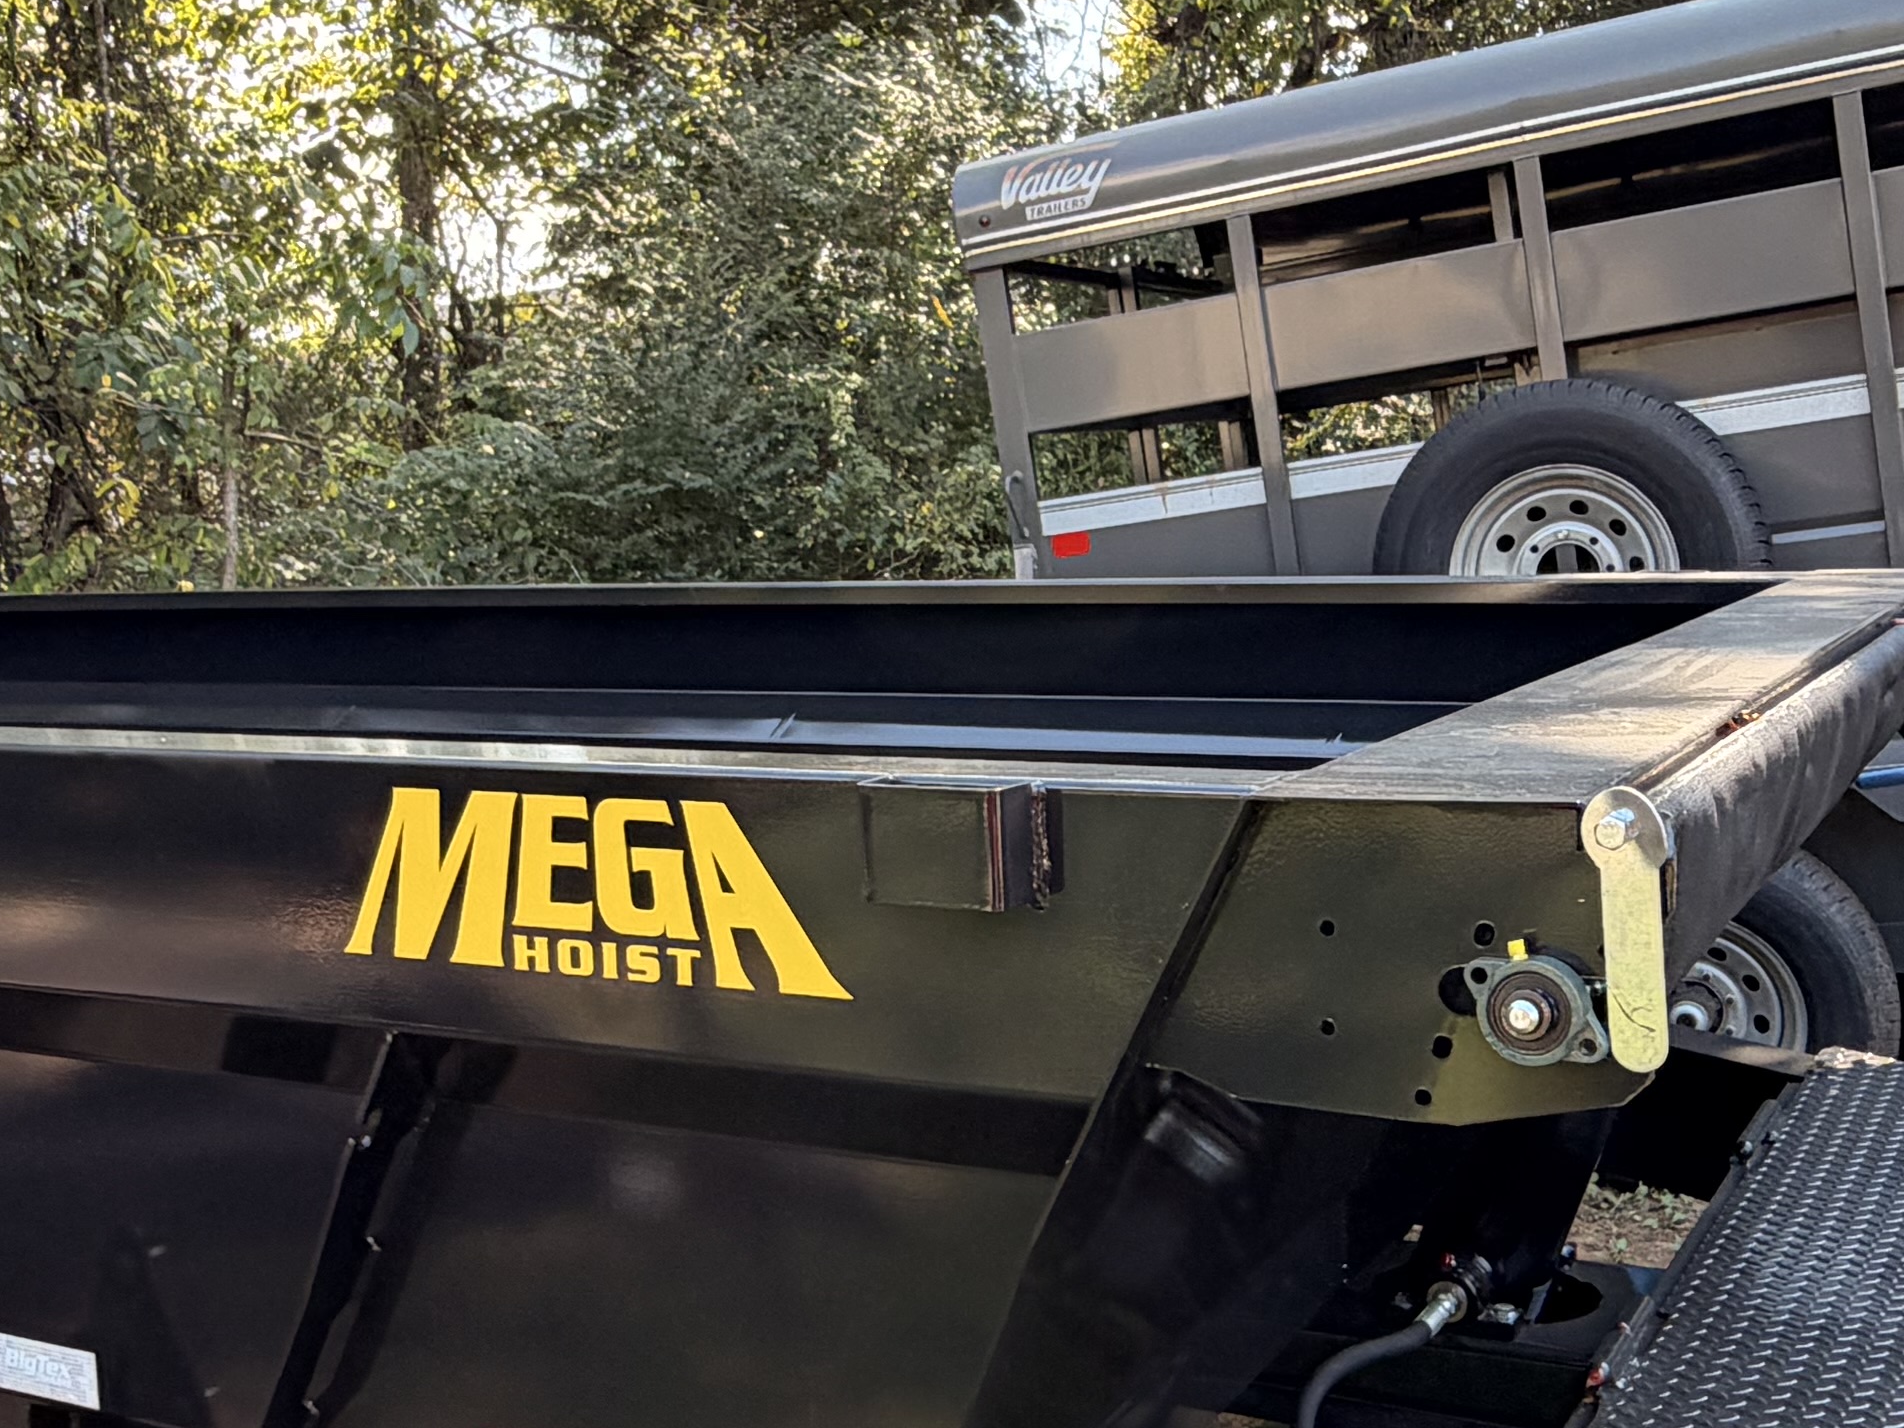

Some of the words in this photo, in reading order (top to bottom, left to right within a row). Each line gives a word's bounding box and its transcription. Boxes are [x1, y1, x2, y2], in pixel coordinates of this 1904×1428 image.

[1000, 158, 1112, 210] Valley
[1029, 197, 1087, 218] TRAILERS
[344, 786, 854, 1001] MEGA
[512, 933, 701, 987] HOIST
